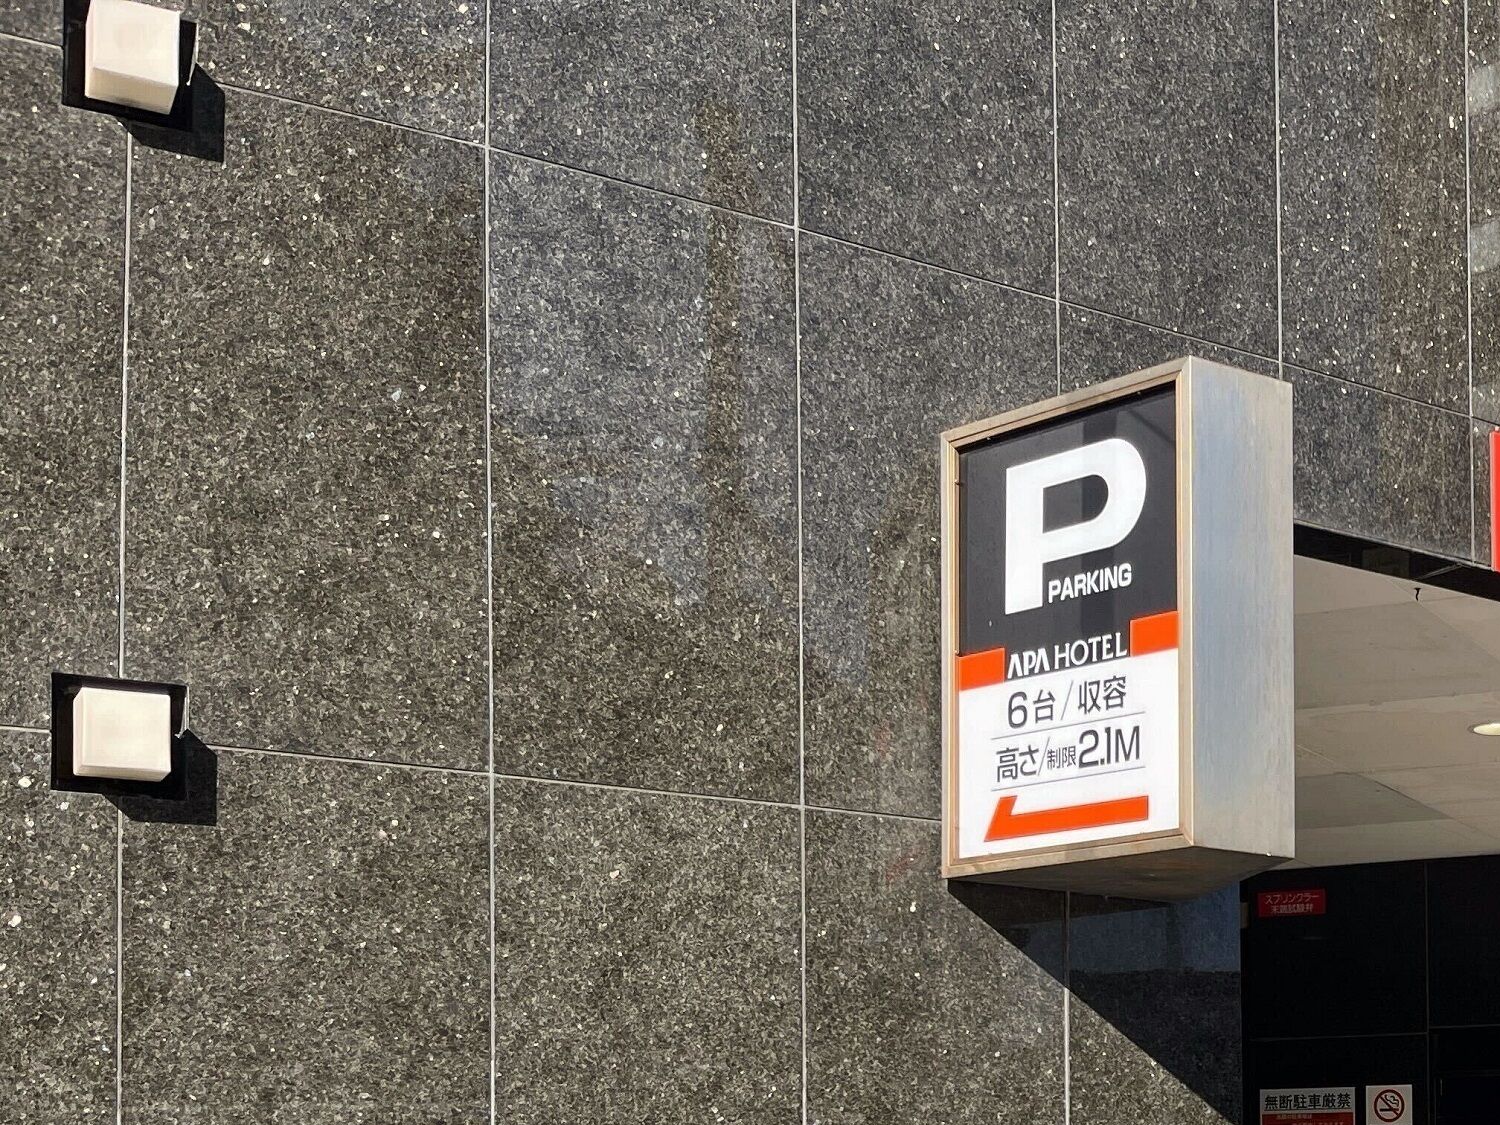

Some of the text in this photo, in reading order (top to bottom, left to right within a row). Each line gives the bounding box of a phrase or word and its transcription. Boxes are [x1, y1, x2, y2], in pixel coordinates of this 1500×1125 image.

[1005, 438, 1147, 615] P
[1048, 563, 1132, 603] PARKING
[1007, 632, 1127, 679] APA HOTEL
[1264, 1092, 1351, 1110] 無断駐車厳禁
